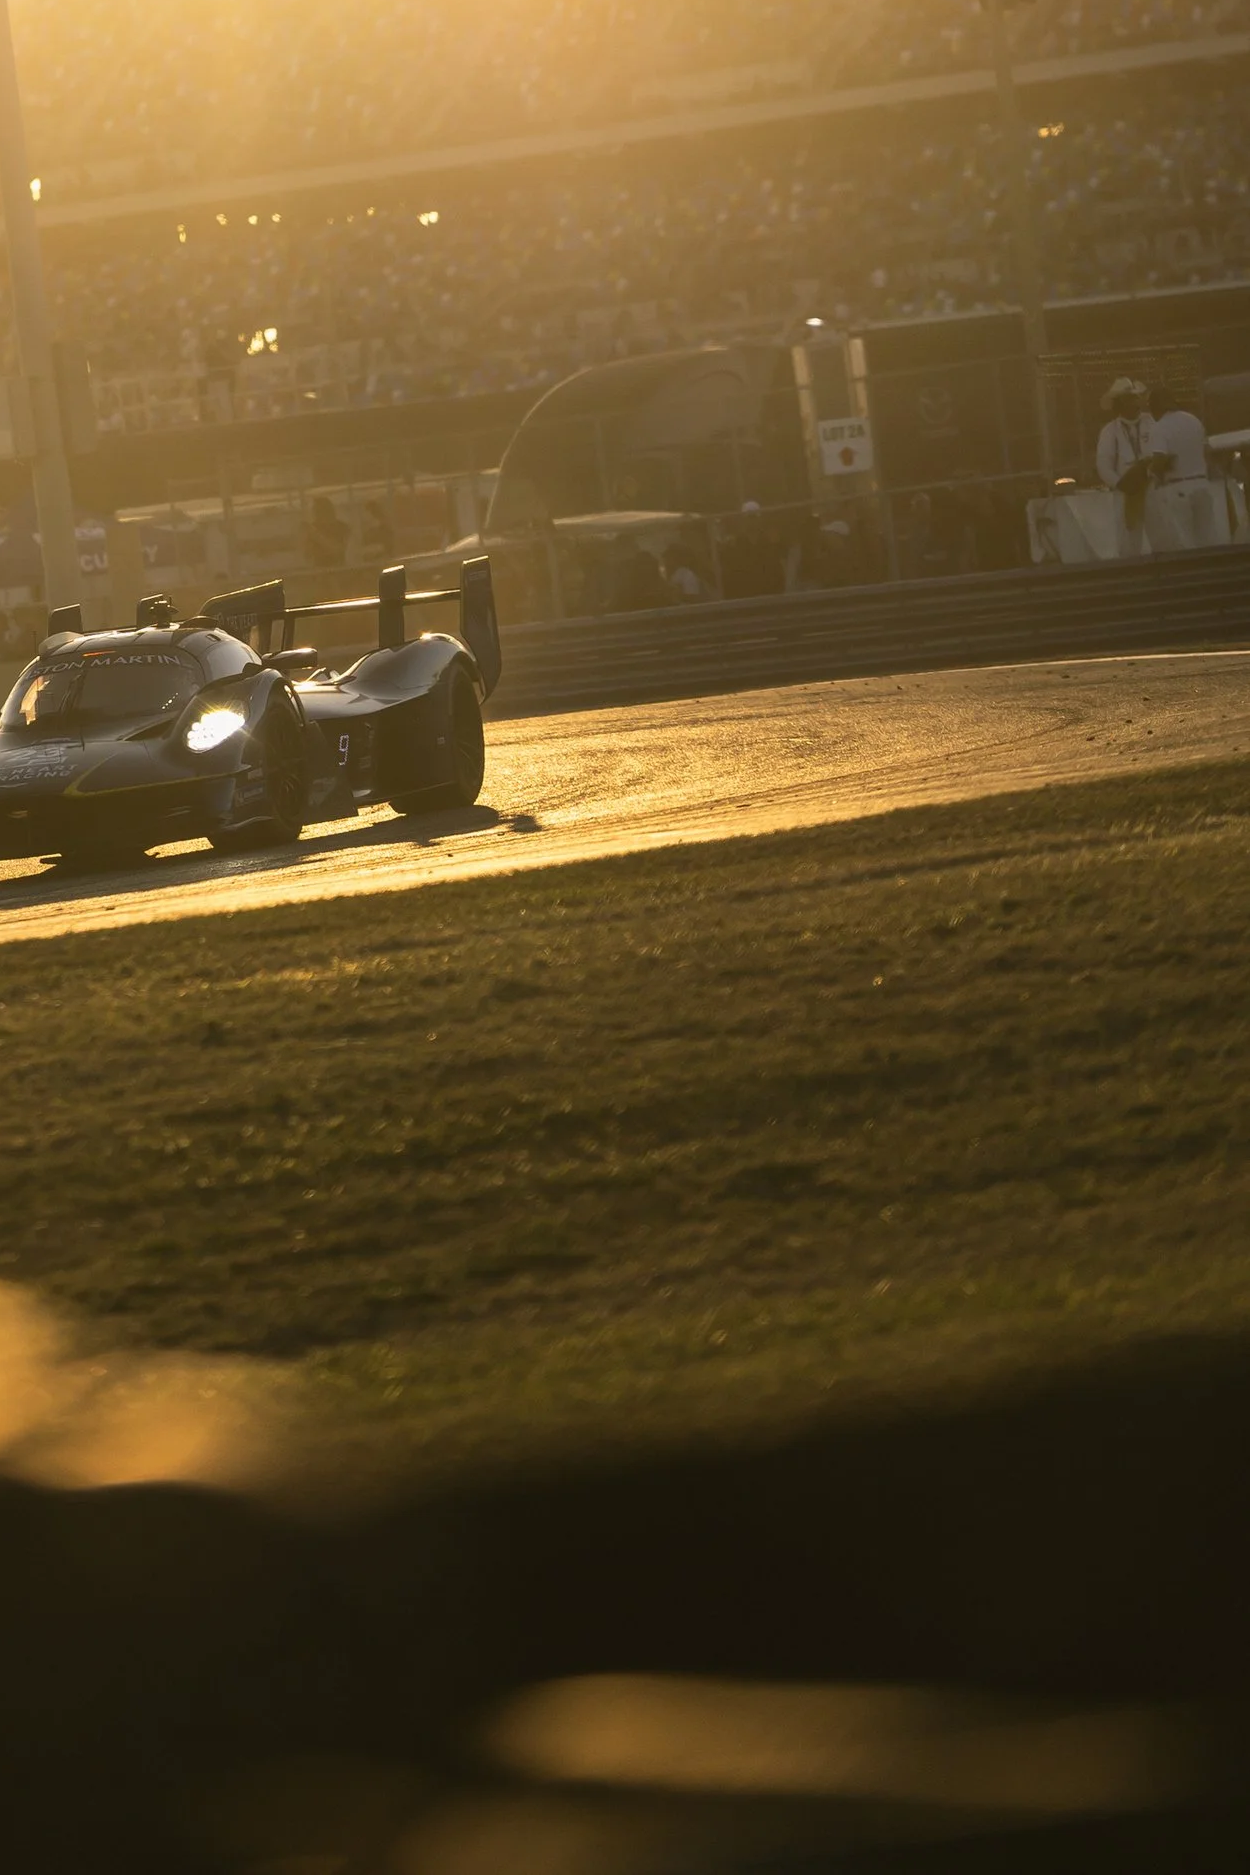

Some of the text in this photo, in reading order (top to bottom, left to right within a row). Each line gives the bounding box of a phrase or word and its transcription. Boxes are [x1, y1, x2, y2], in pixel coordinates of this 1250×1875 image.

[822, 426, 845, 442] LOT
[91, 654, 181, 667] MARTIN
[12, 764, 78, 774] HEART
